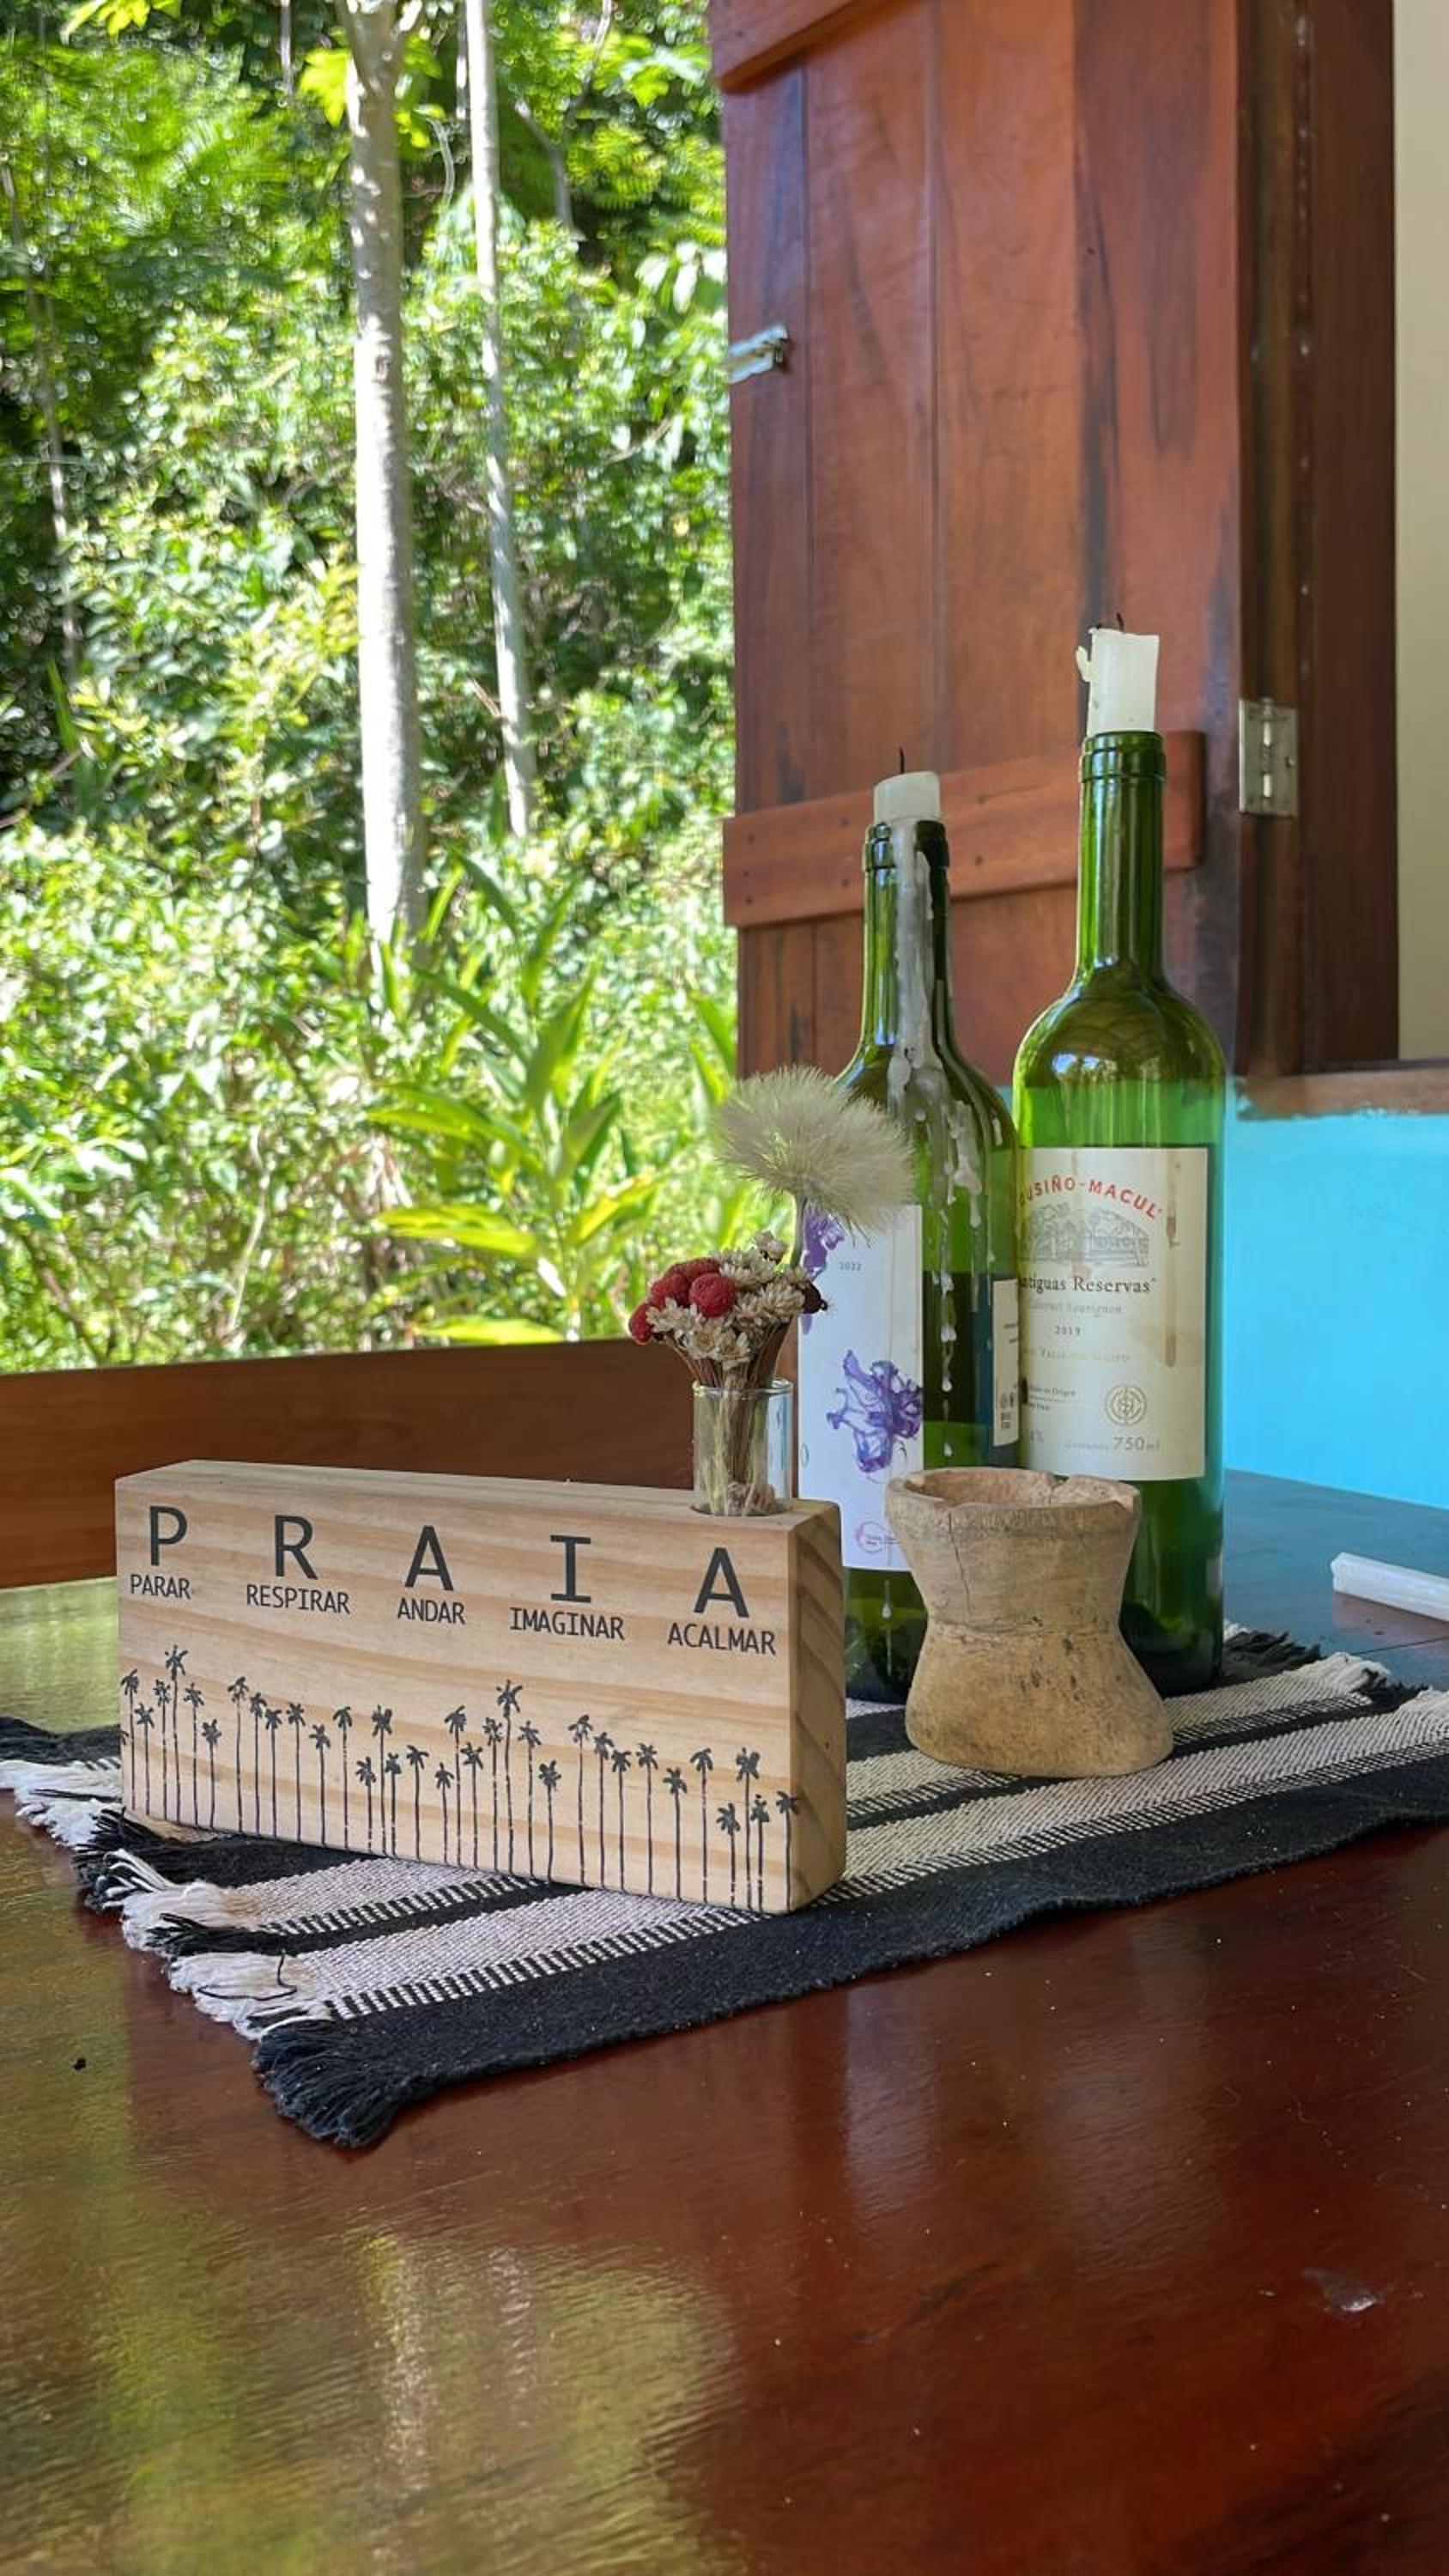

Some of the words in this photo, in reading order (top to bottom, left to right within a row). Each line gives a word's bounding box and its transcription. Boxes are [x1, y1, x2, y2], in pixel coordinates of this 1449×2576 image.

[1073, 1275, 1151, 1293] Reservas
[130, 1573, 191, 1601] PARAR
[246, 1583, 351, 1614] RESPIRAR
[397, 1597, 466, 1625] ANDAR
[509, 1607, 625, 1641] IMAGINAR
[667, 1622, 777, 1656] ACALMAR
